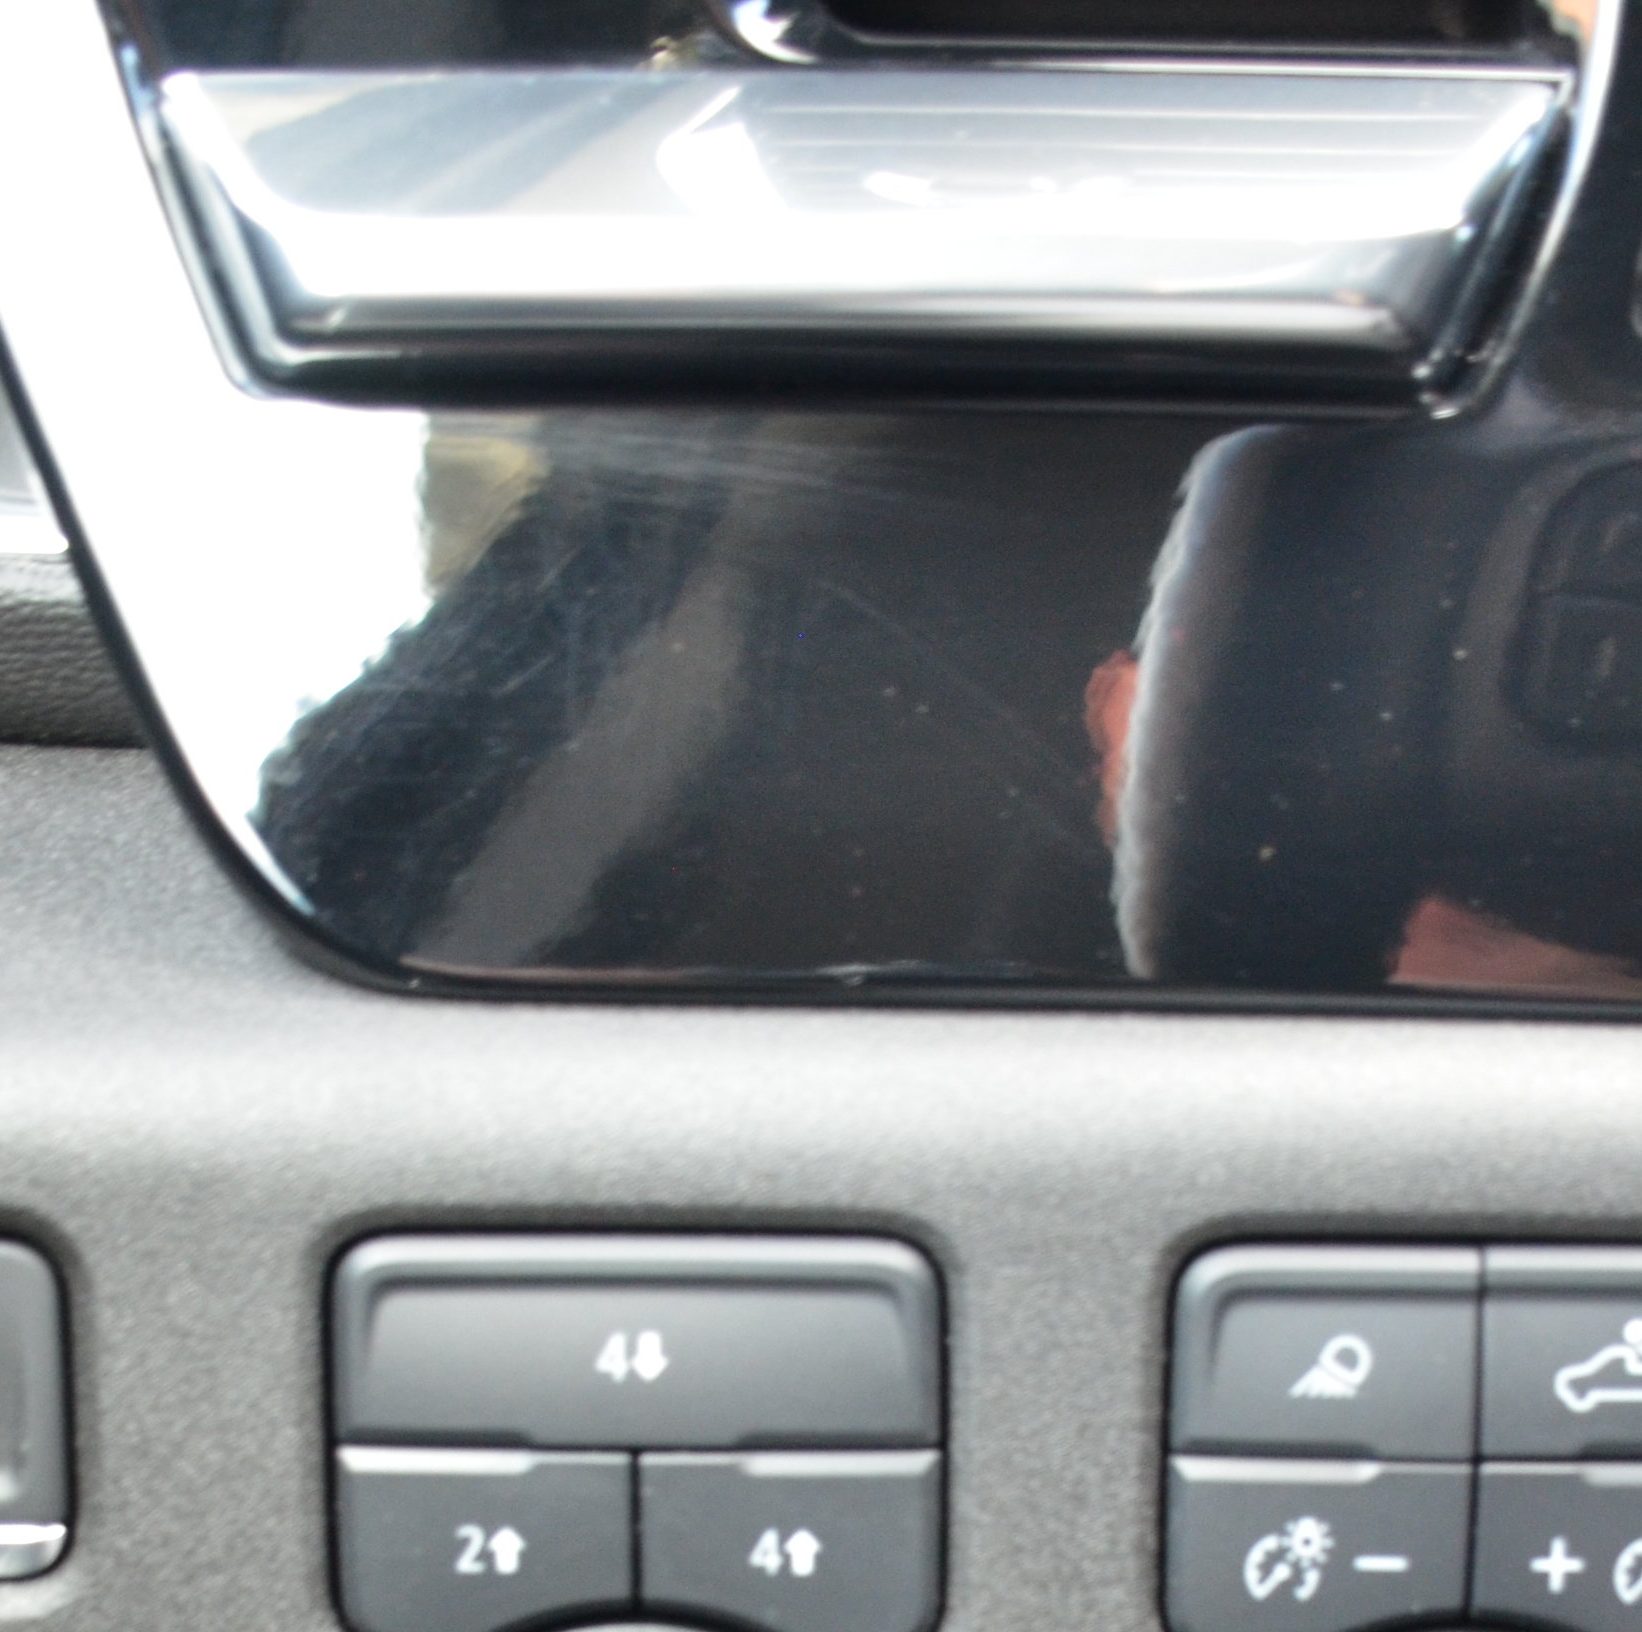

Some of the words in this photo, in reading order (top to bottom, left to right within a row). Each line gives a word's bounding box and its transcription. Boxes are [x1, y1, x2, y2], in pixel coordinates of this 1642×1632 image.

[594, 1332, 629, 1382] 4
[454, 1525, 487, 1574] 2
[748, 1529, 783, 1576] 4
